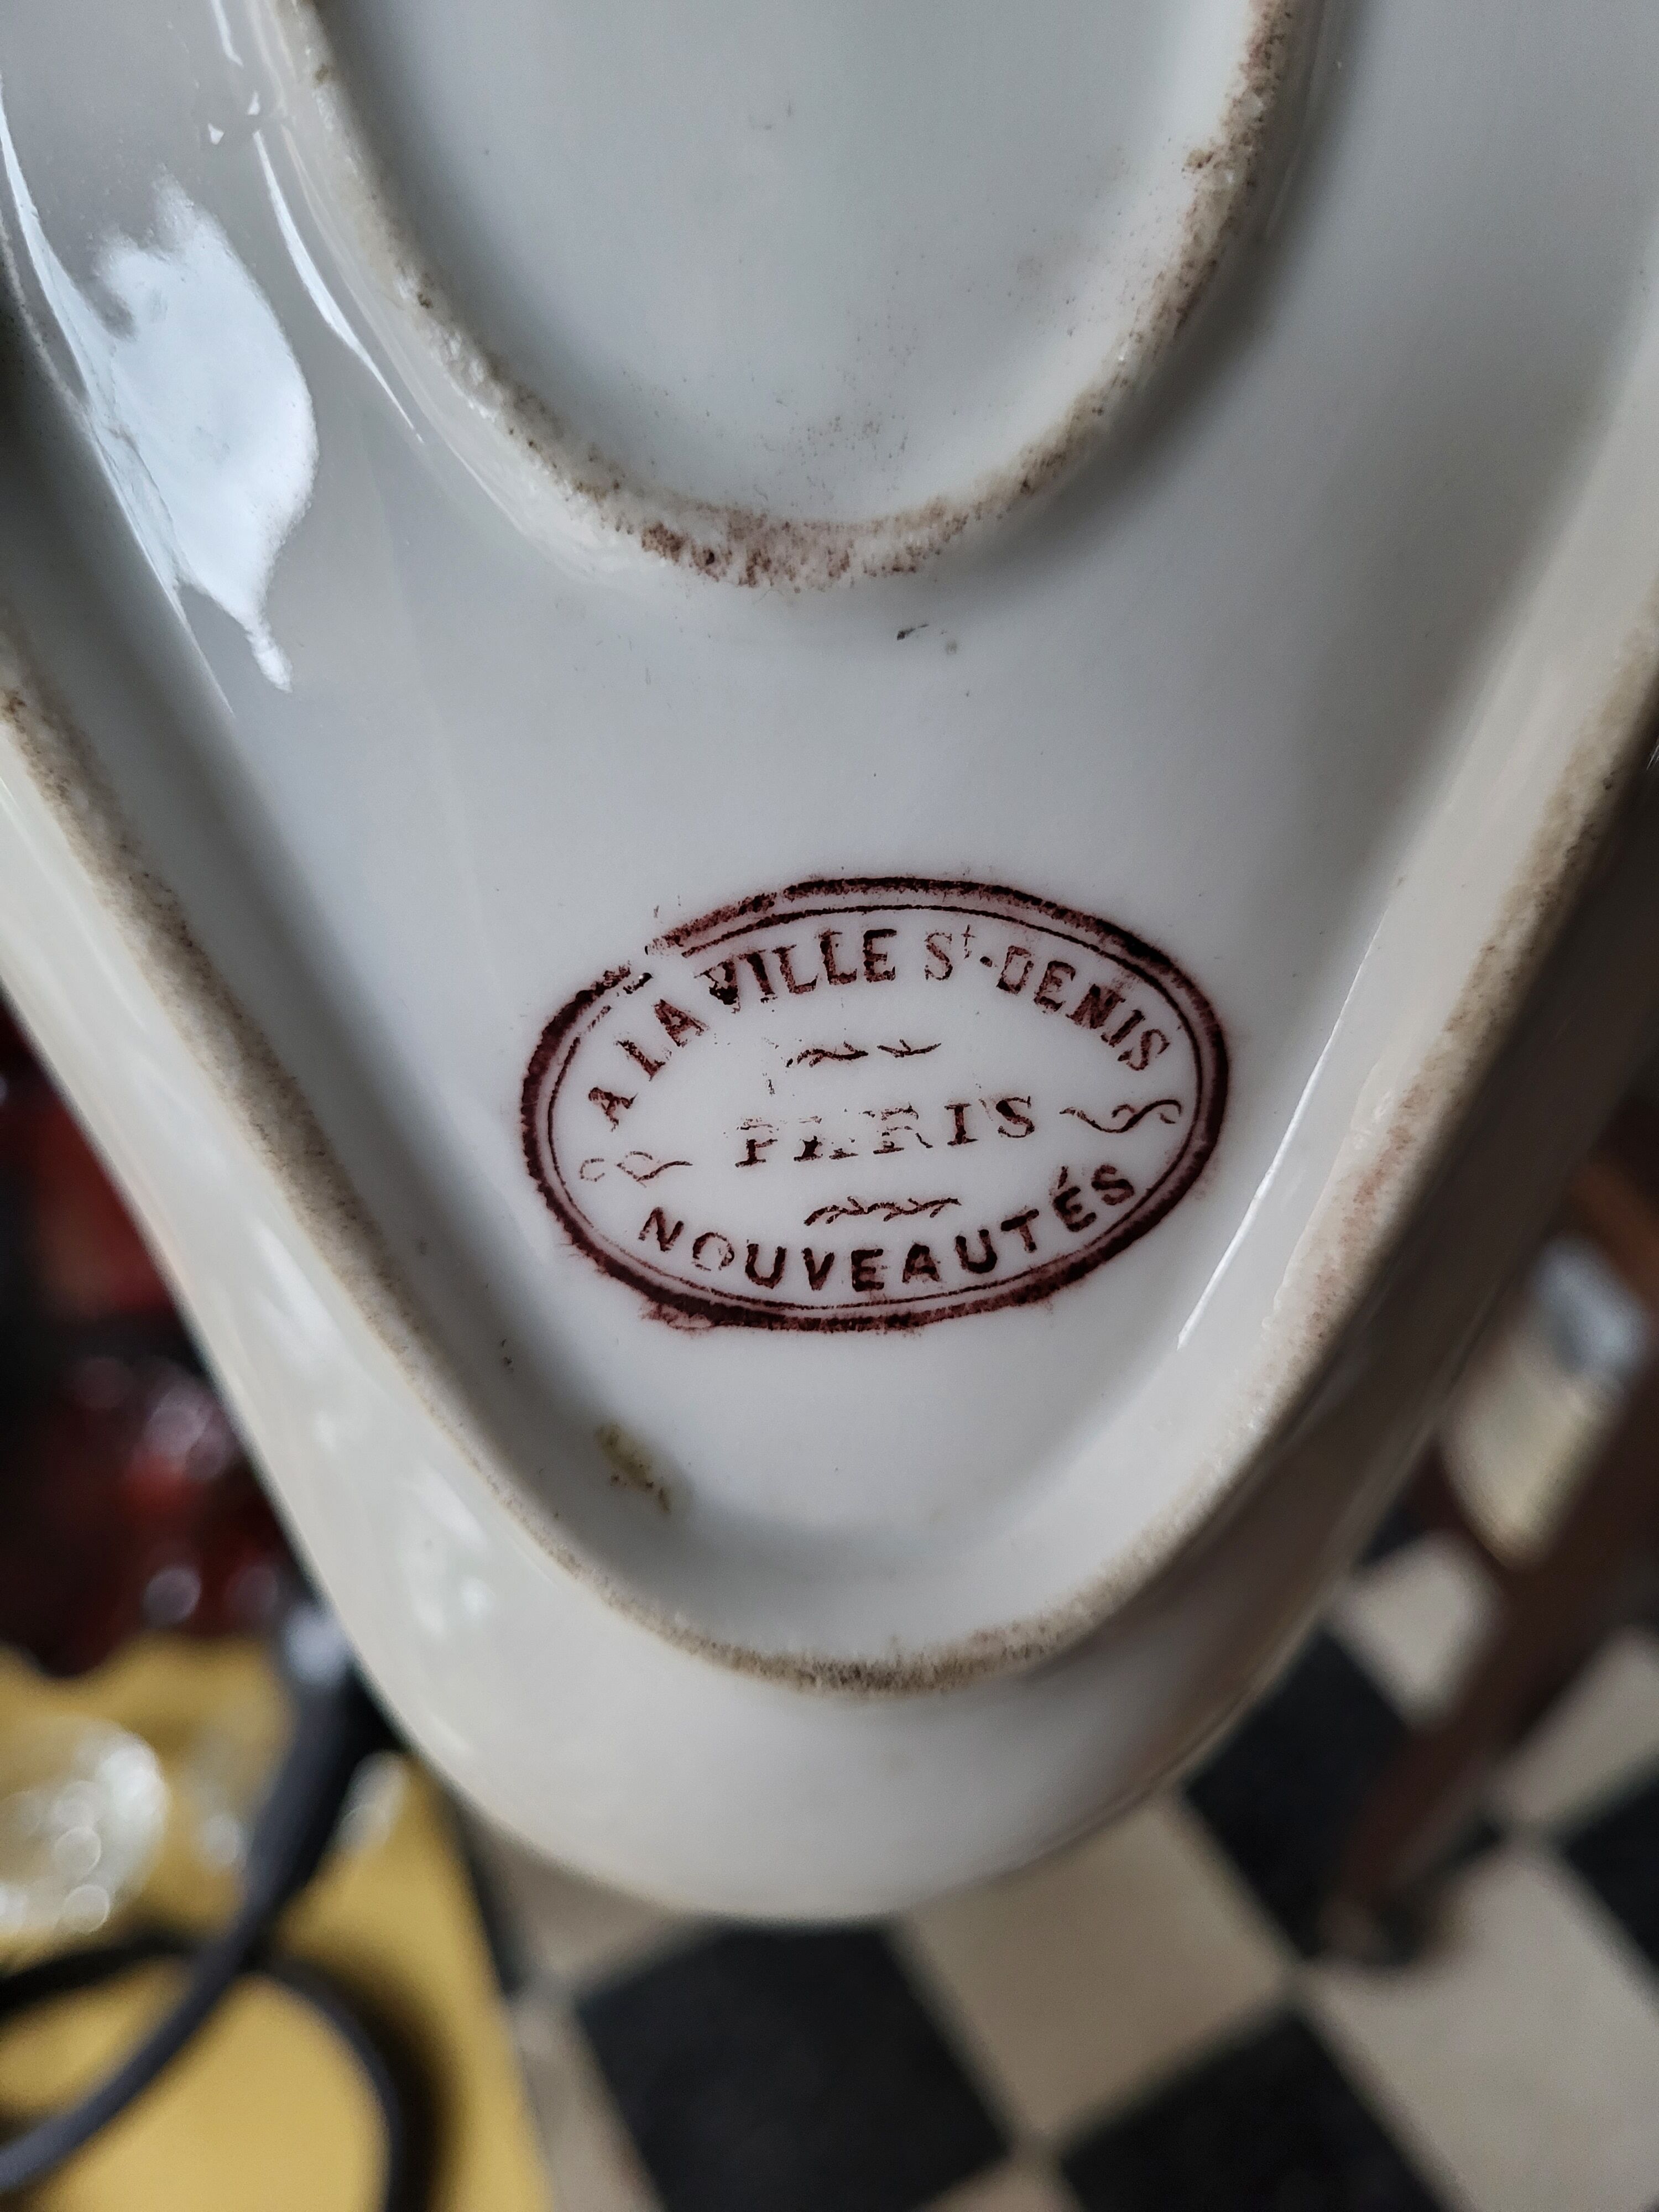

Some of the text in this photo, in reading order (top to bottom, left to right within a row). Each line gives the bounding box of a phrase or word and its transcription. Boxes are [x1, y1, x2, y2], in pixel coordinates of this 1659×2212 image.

[588, 1086, 637, 1132] A
[617, 999, 709, 1081] LA
[695, 928, 897, 1014] VILLE
[997, 945, 1170, 1071] DENIS
[638, 1164, 1135, 1292] NOUVEAUTÉS
